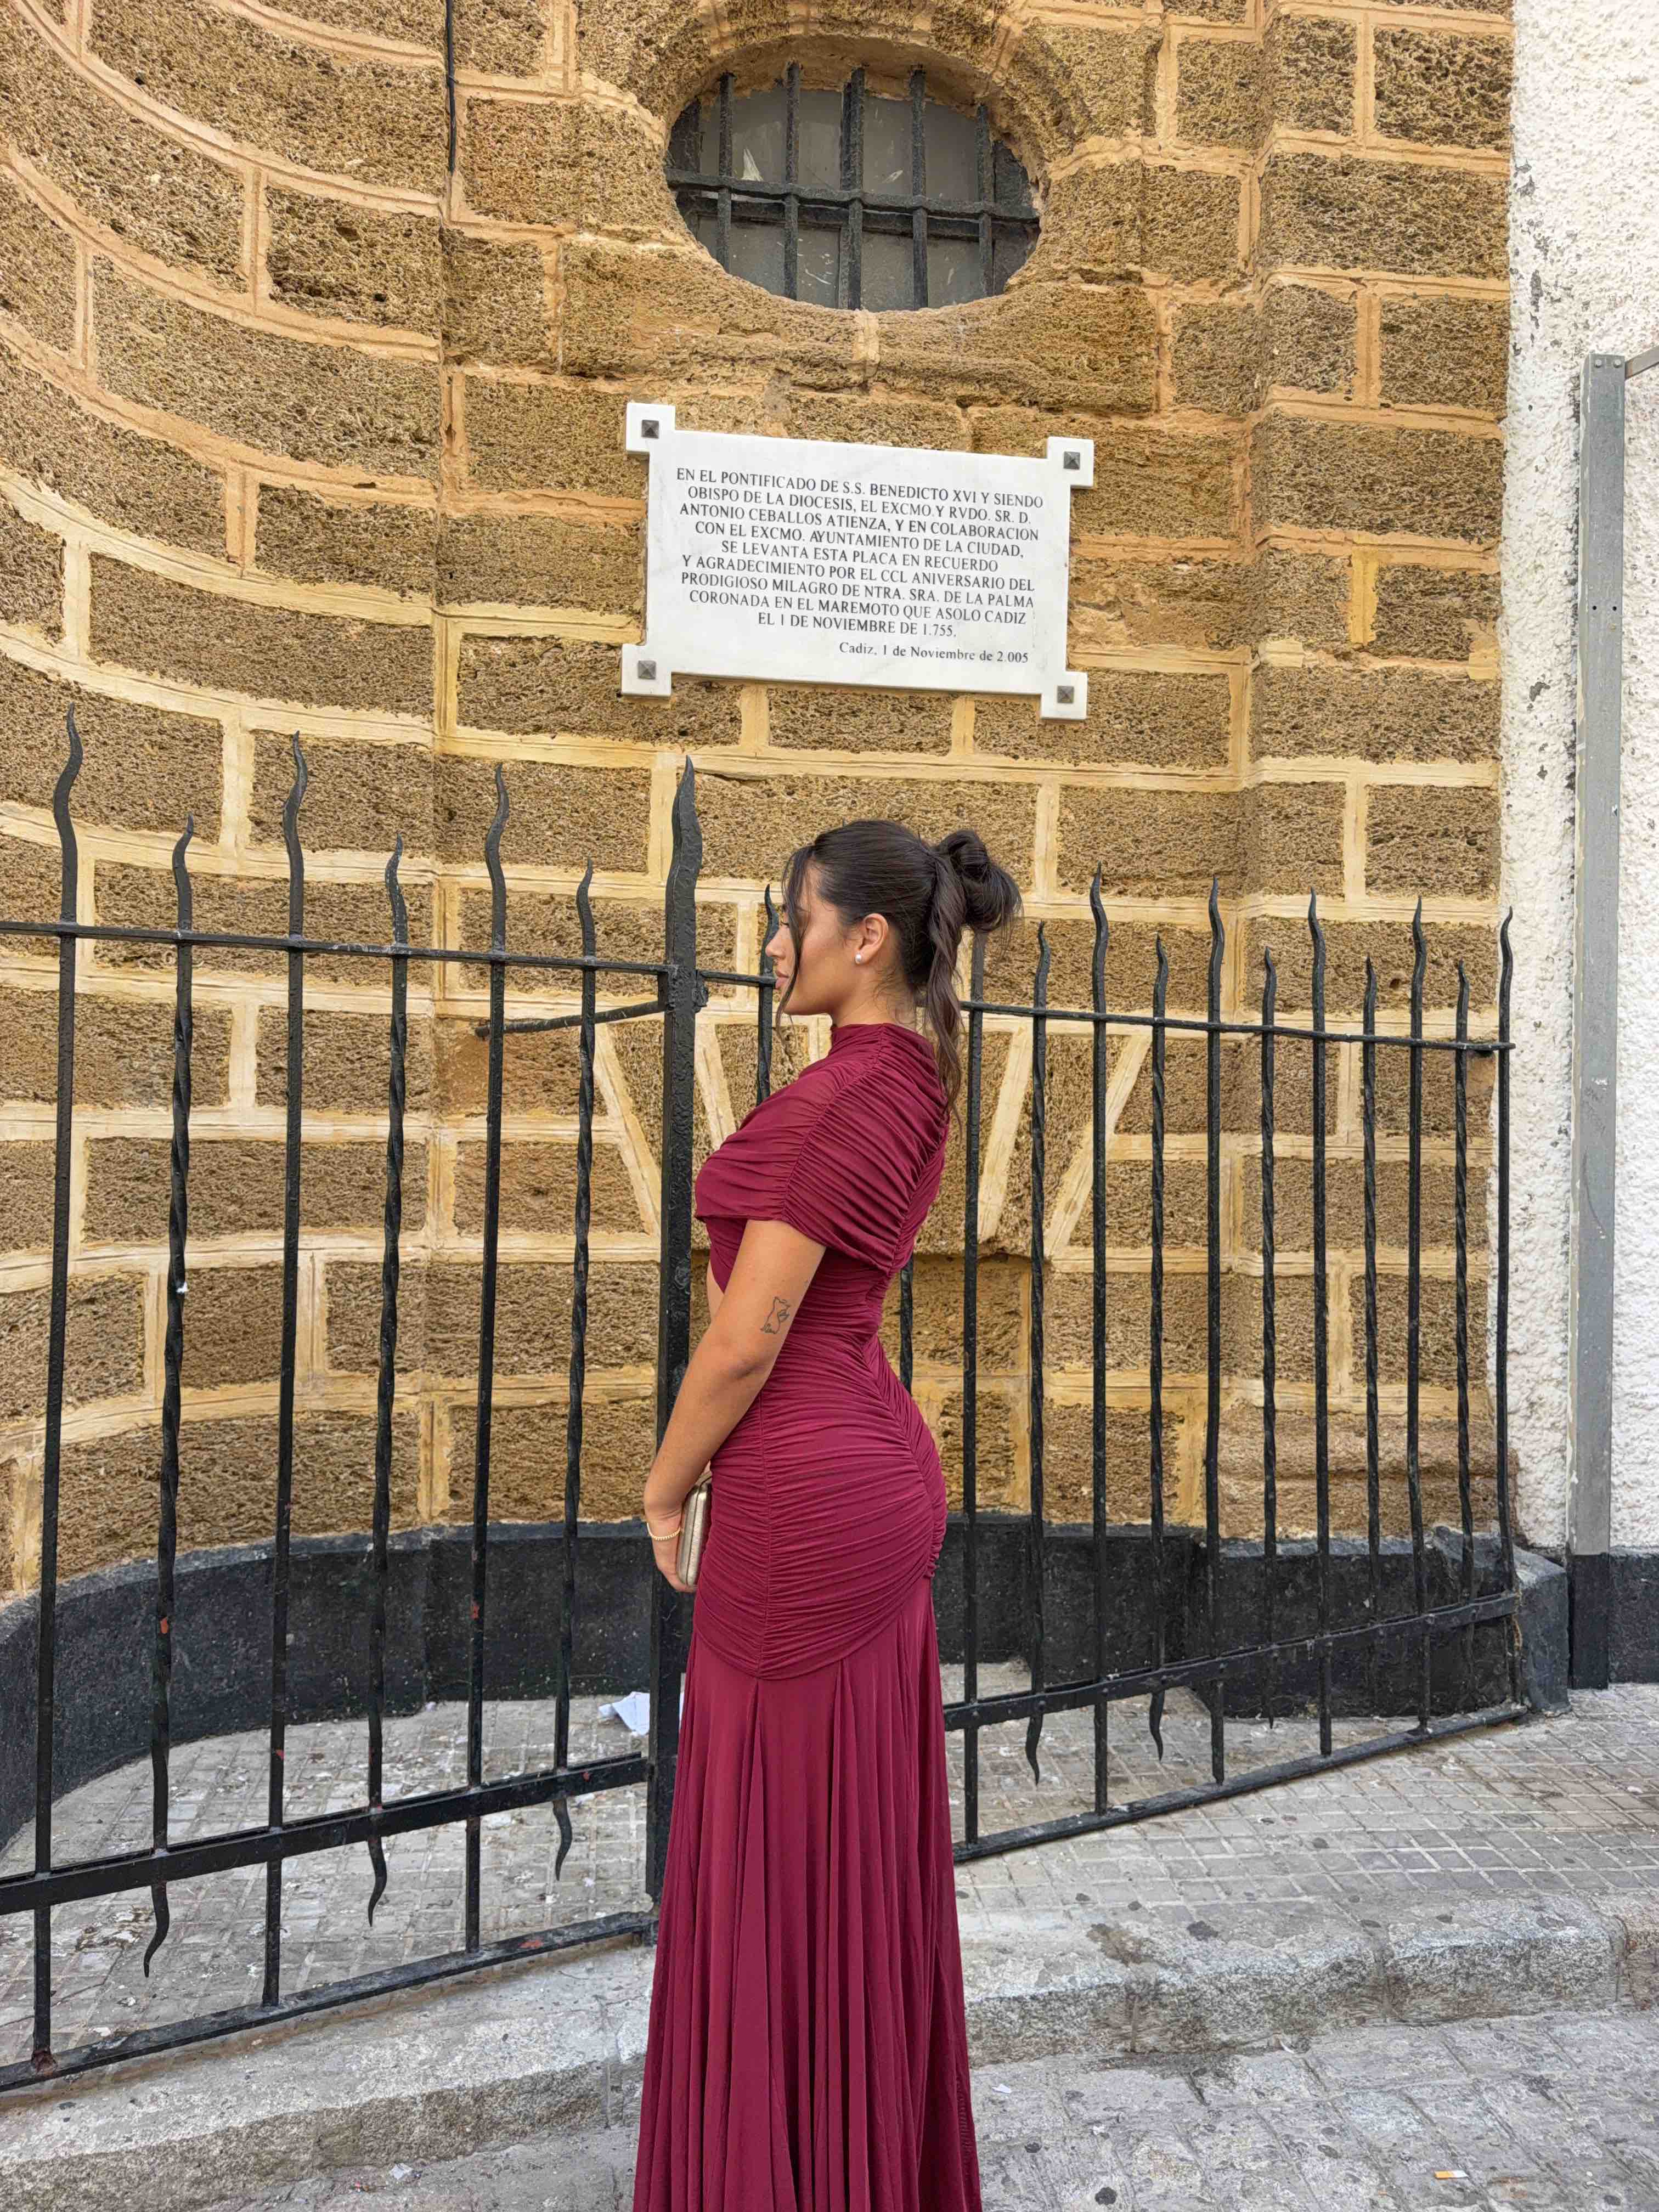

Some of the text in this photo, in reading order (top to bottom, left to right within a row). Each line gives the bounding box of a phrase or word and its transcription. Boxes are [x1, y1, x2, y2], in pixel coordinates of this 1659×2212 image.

[676, 467, 1043, 509] EN EL PONTIFICADO DE S.S. BENEDICTO XVI Y SIENDO
[687, 486, 740, 502] OBISPO
[743, 490, 762, 504] DE
[766, 492, 785, 506] LA
[789, 494, 856, 514] DIOCESIS,
[860, 499, 878, 513] EL
[949, 506, 991, 521] RVDO.
[994, 509, 1014, 523] SR.
[1018, 511, 1031, 524] D.
[679, 503, 1039, 541] ANTONIO CEBALLOS ATIENZA, Y EN COLABORACION
[695, 521, 1024, 559] CON EL EXCMO. AYUNTAMIENTO DE LA CIUDAD,
[681, 554, 1035, 592] Y AGRADECIMIENTO POR EL CCL ANIVERSARIO DEL
[721, 539, 998, 572] SE LEVANTA ESTA PLACA EN RECUERDO
[681, 571, 1034, 608] PRODIGIOSO MILAGRO DE NTRA. SRA. DE LA PALMA
[689, 589, 1026, 625] CORONADA EN EL MAREMOTO QUE ASOLO CADIZ
[758, 612, 775, 625] EL
[790, 614, 809, 628] DE
[812, 616, 896, 634] NOVIEMBRE
[899, 621, 918, 635] DE
[923, 623, 957, 637] 1.755.
[892, 645, 907, 657] de
[910, 646, 976, 661] Noviembre
[979, 650, 994, 662] de
